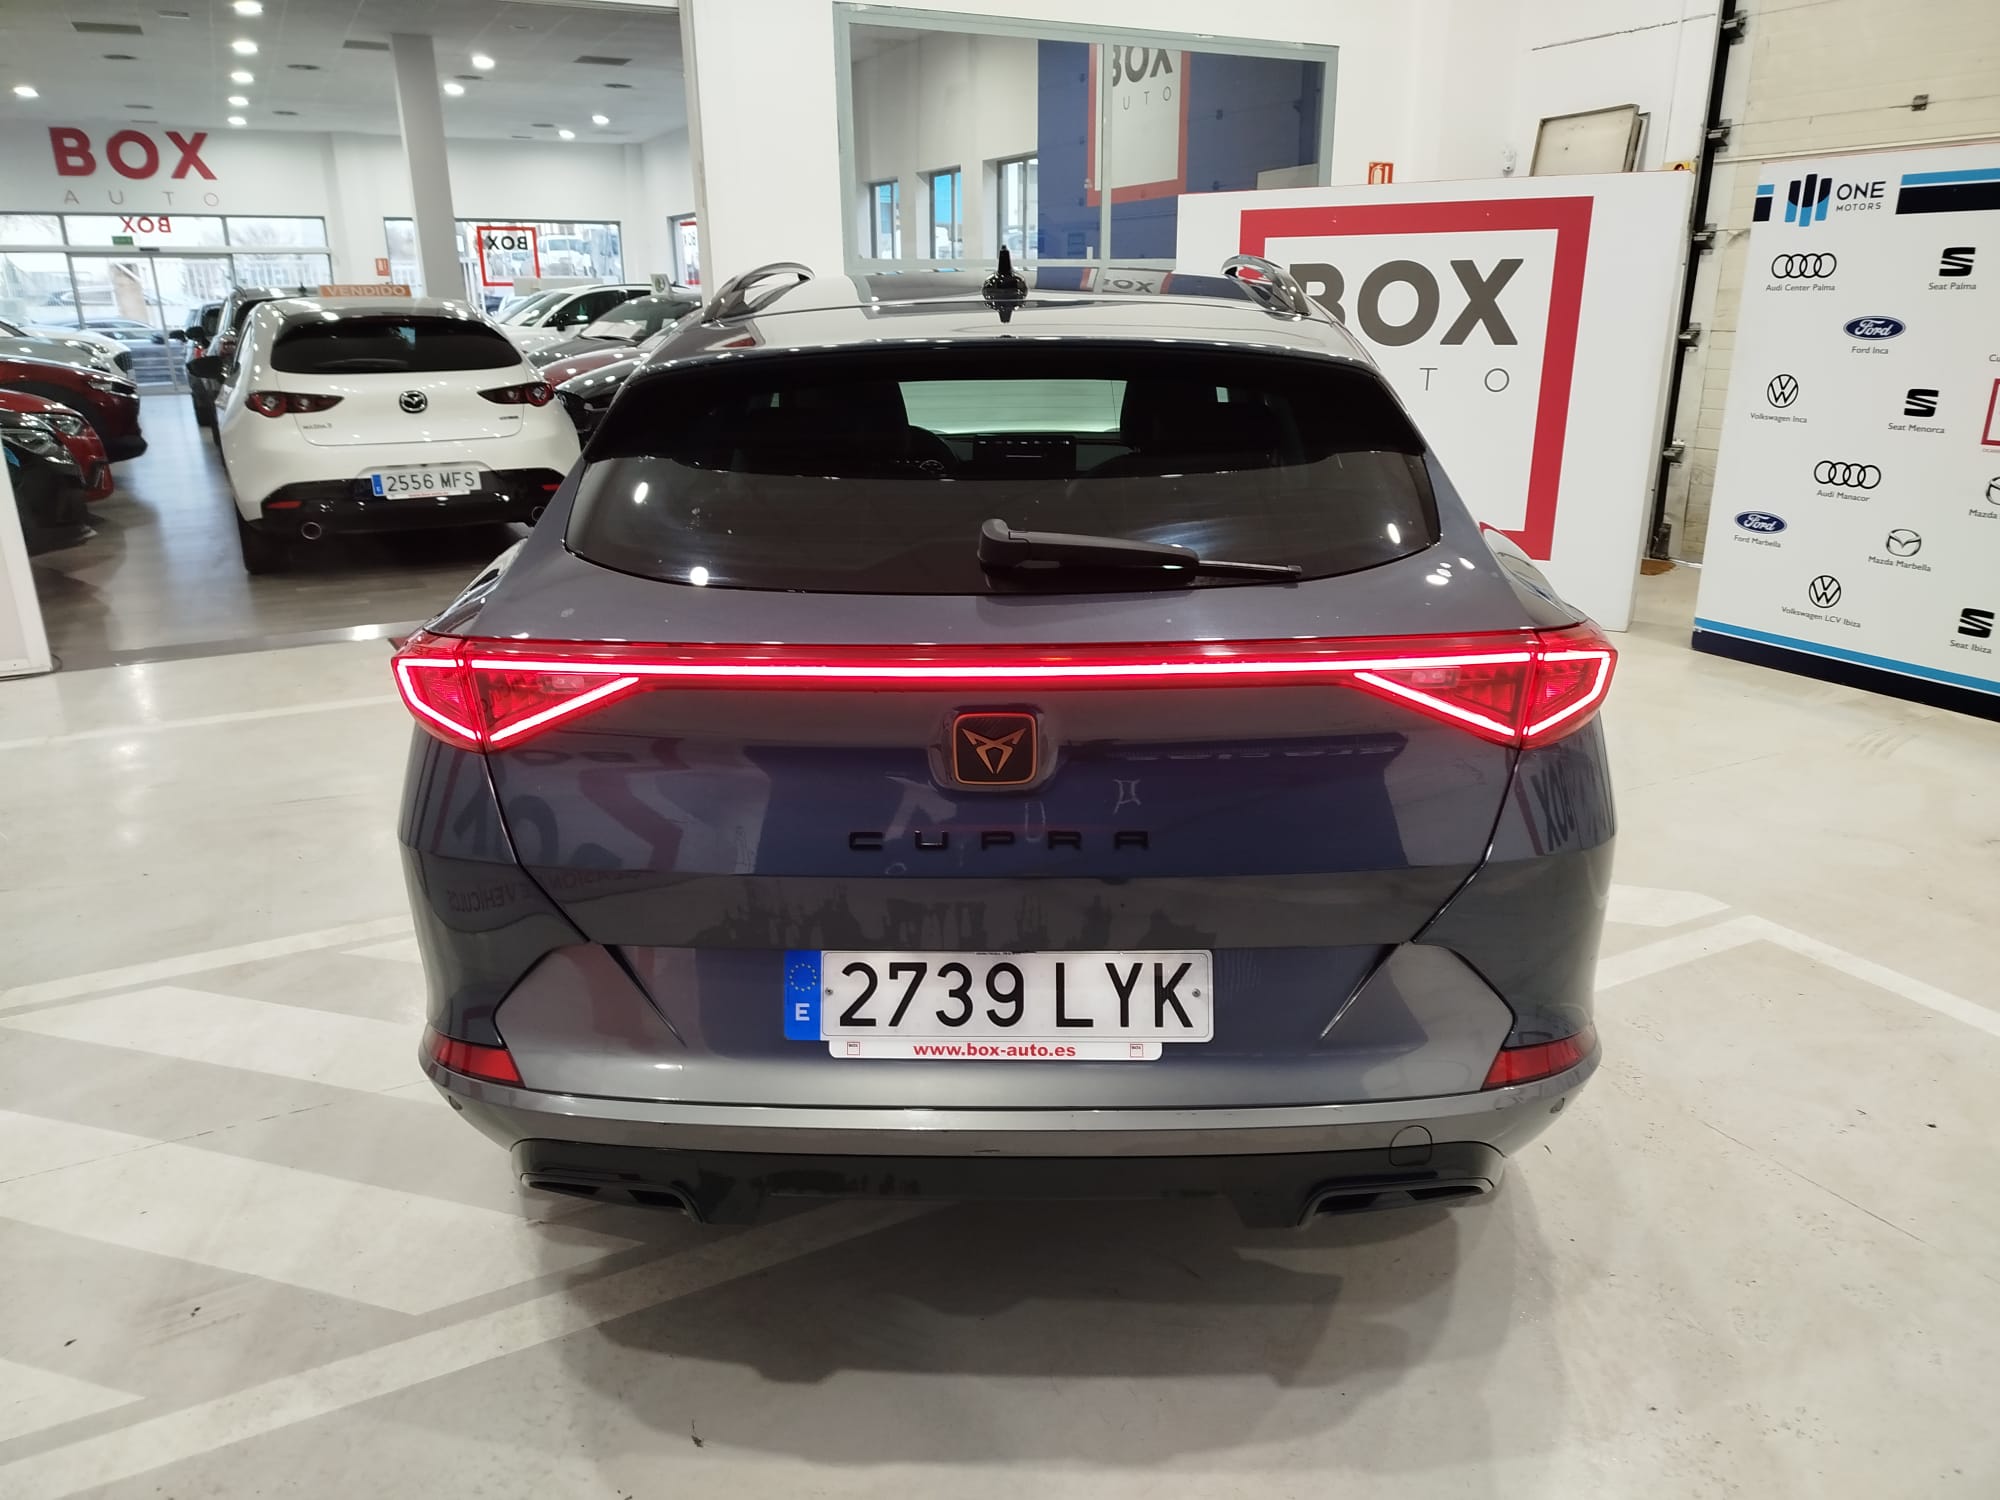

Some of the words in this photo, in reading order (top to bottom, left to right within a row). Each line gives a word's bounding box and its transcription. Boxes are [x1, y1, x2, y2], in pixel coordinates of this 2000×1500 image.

[48, 126, 218, 180] BOX
[64, 190, 220, 207] AUTO
[1836, 181, 1887, 200] ONE
[1836, 202, 1882, 212] MOTORS
[326, 284, 407, 297] VENDIDO
[1766, 284, 1783, 292] Audi
[1784, 284, 1811, 292] Center
[1812, 283, 1836, 292] Palma
[1928, 282, 1948, 291] Seat
[1949, 281, 1977, 290] Palma
[1854, 319, 1894, 336] Ford
[1851, 345, 1871, 354] Ford
[1872, 346, 1889, 355] Inca
[1750, 412, 1791, 424] Volkswagen
[1792, 415, 1808, 424] Inca
[1888, 422, 1906, 431] Seat
[1907, 423, 1945, 434] Menorca
[386, 473, 434, 493] 2556
[439, 471, 475, 488] MFS
[1816, 489, 1835, 498] Audi
[1836, 491, 1871, 502] Manacor
[1968, 508, 1998, 519] Mazda
[1743, 513, 1778, 531] Ford
[1734, 534, 1750, 544] Ford
[1751, 537, 1782, 548] Marbella
[1868, 555, 1894, 566] Mazda
[1895, 559, 1932, 572] Marbella
[1781, 606, 1823, 621] Volkswagen
[1824, 614, 1842, 624] LCV
[1843, 618, 1861, 629] Ibiza
[1949, 638, 1969, 650] Seat
[1970, 643, 1992, 655] Ibiza
[849, 831, 1150, 851] CUPRA
[795, 1003, 810, 1021] E
[839, 961, 1025, 1028] 2739
[1055, 961, 1193, 1028] LYK
[912, 1042, 1077, 1058] www.box-auto.es
